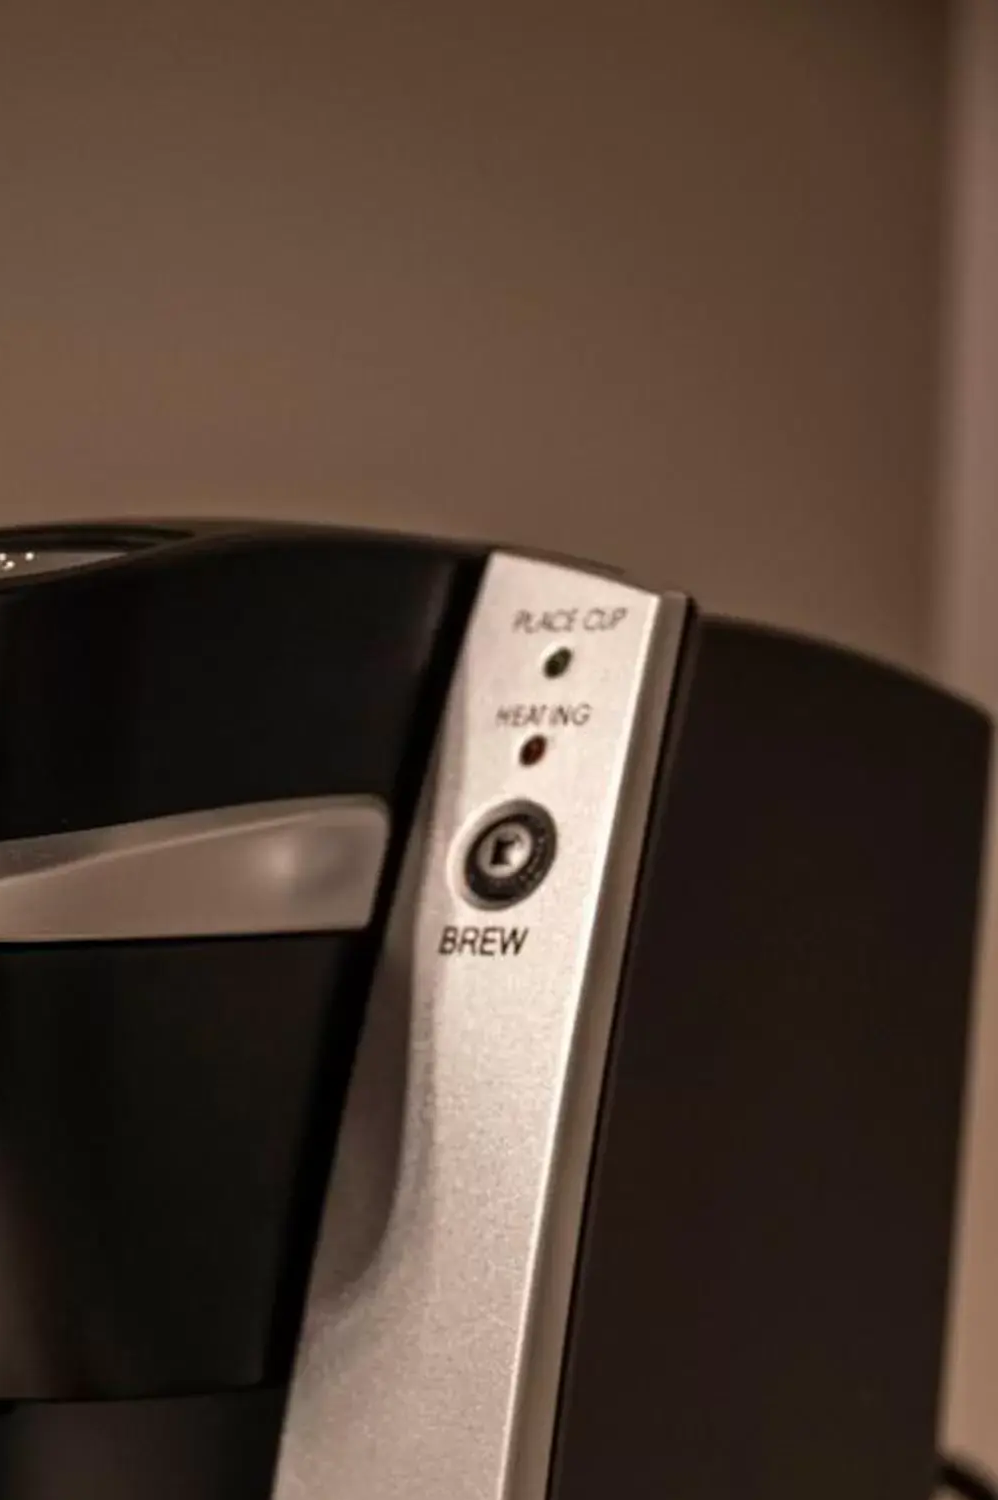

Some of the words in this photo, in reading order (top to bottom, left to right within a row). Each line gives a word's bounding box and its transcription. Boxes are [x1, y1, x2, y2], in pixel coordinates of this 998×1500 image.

[513, 609, 579, 633] PLACE
[583, 607, 628, 632] CUP
[495, 703, 593, 727] HEATING
[437, 926, 529, 957] BREW
